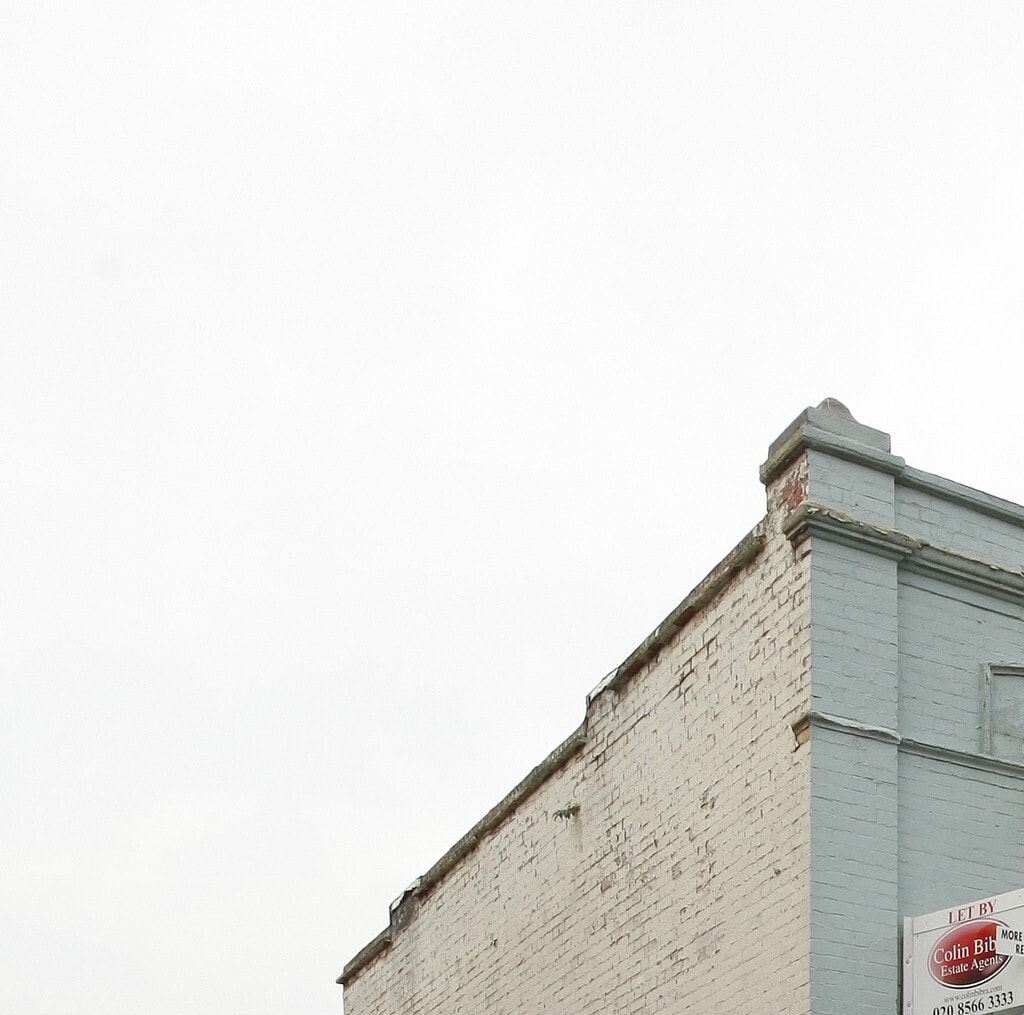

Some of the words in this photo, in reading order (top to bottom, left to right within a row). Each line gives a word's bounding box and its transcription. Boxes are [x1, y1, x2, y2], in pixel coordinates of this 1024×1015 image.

[948, 905, 975, 924] LET
[979, 900, 997, 915] BY
[1001, 929, 1023, 942] MORE
[933, 943, 970, 964] Colin
[973, 937, 997, 955] Bib
[941, 961, 969, 977] Estate
[971, 955, 1003, 971] Agents
[957, 998, 985, 1015] 8566
[988, 991, 1014, 1009] 3333
